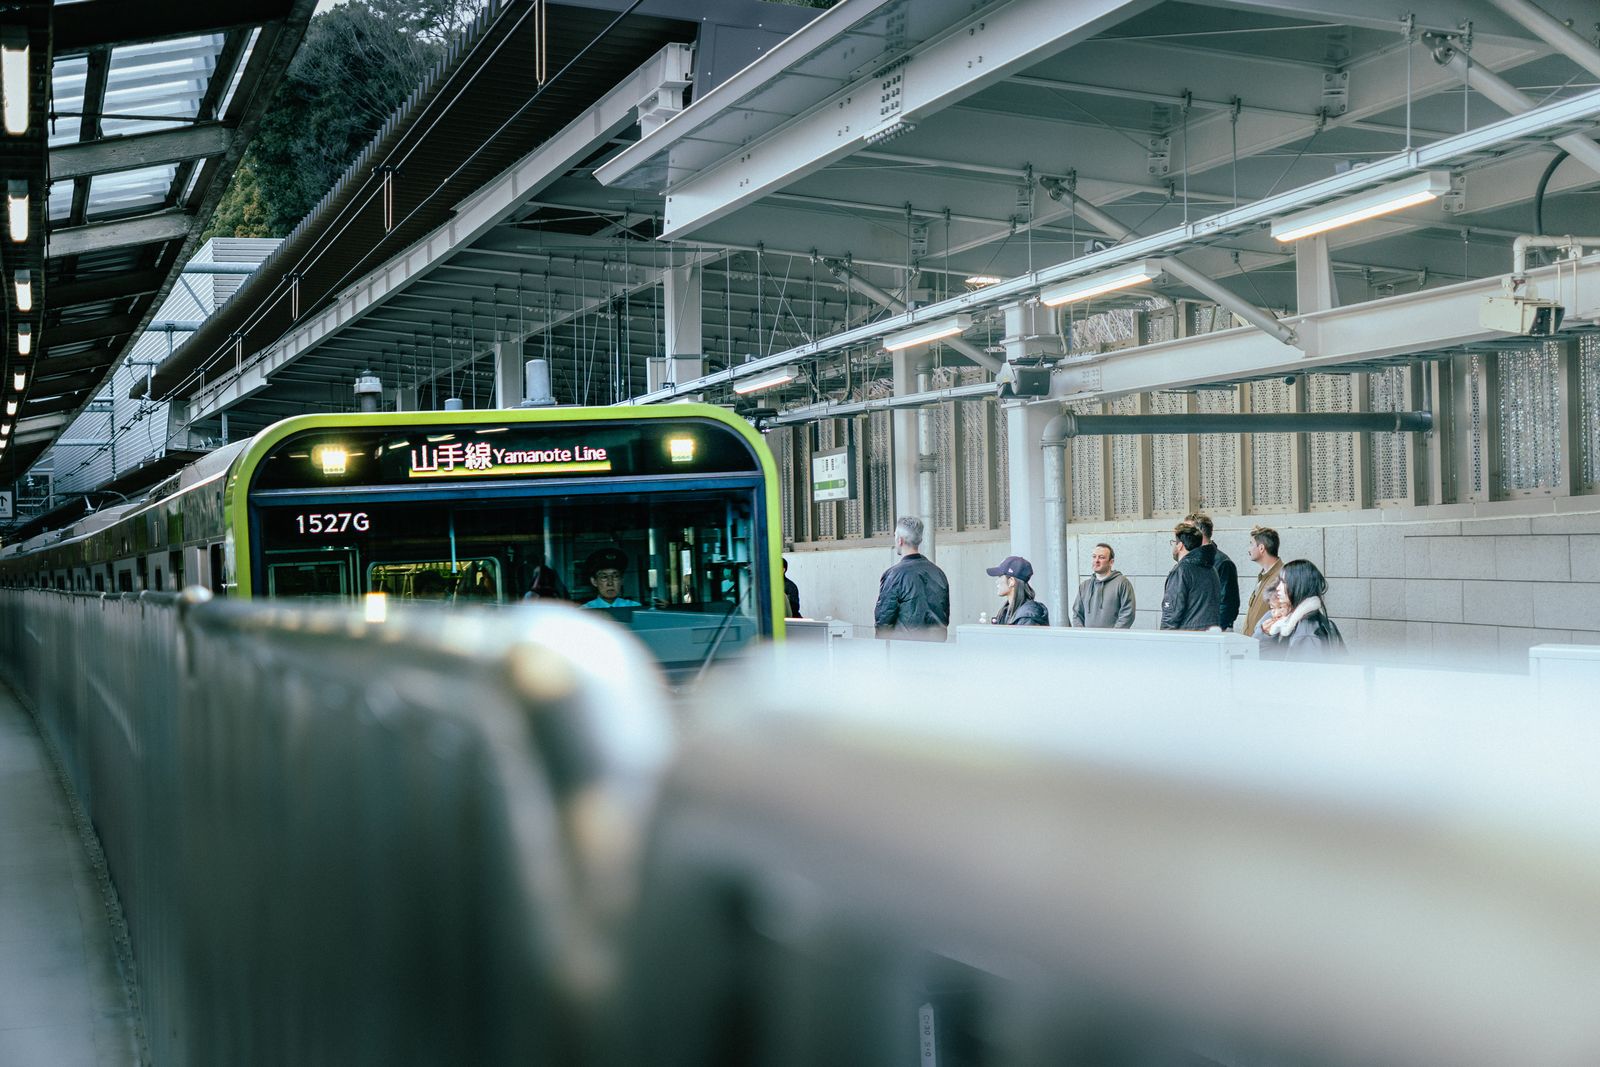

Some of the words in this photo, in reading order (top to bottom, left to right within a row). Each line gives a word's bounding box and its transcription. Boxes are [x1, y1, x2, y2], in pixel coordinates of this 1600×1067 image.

[411, 442, 493, 471] 山手線
[492, 448, 572, 464] Yamanote
[574, 446, 607, 461] Line
[295, 512, 370, 534] 1527G
